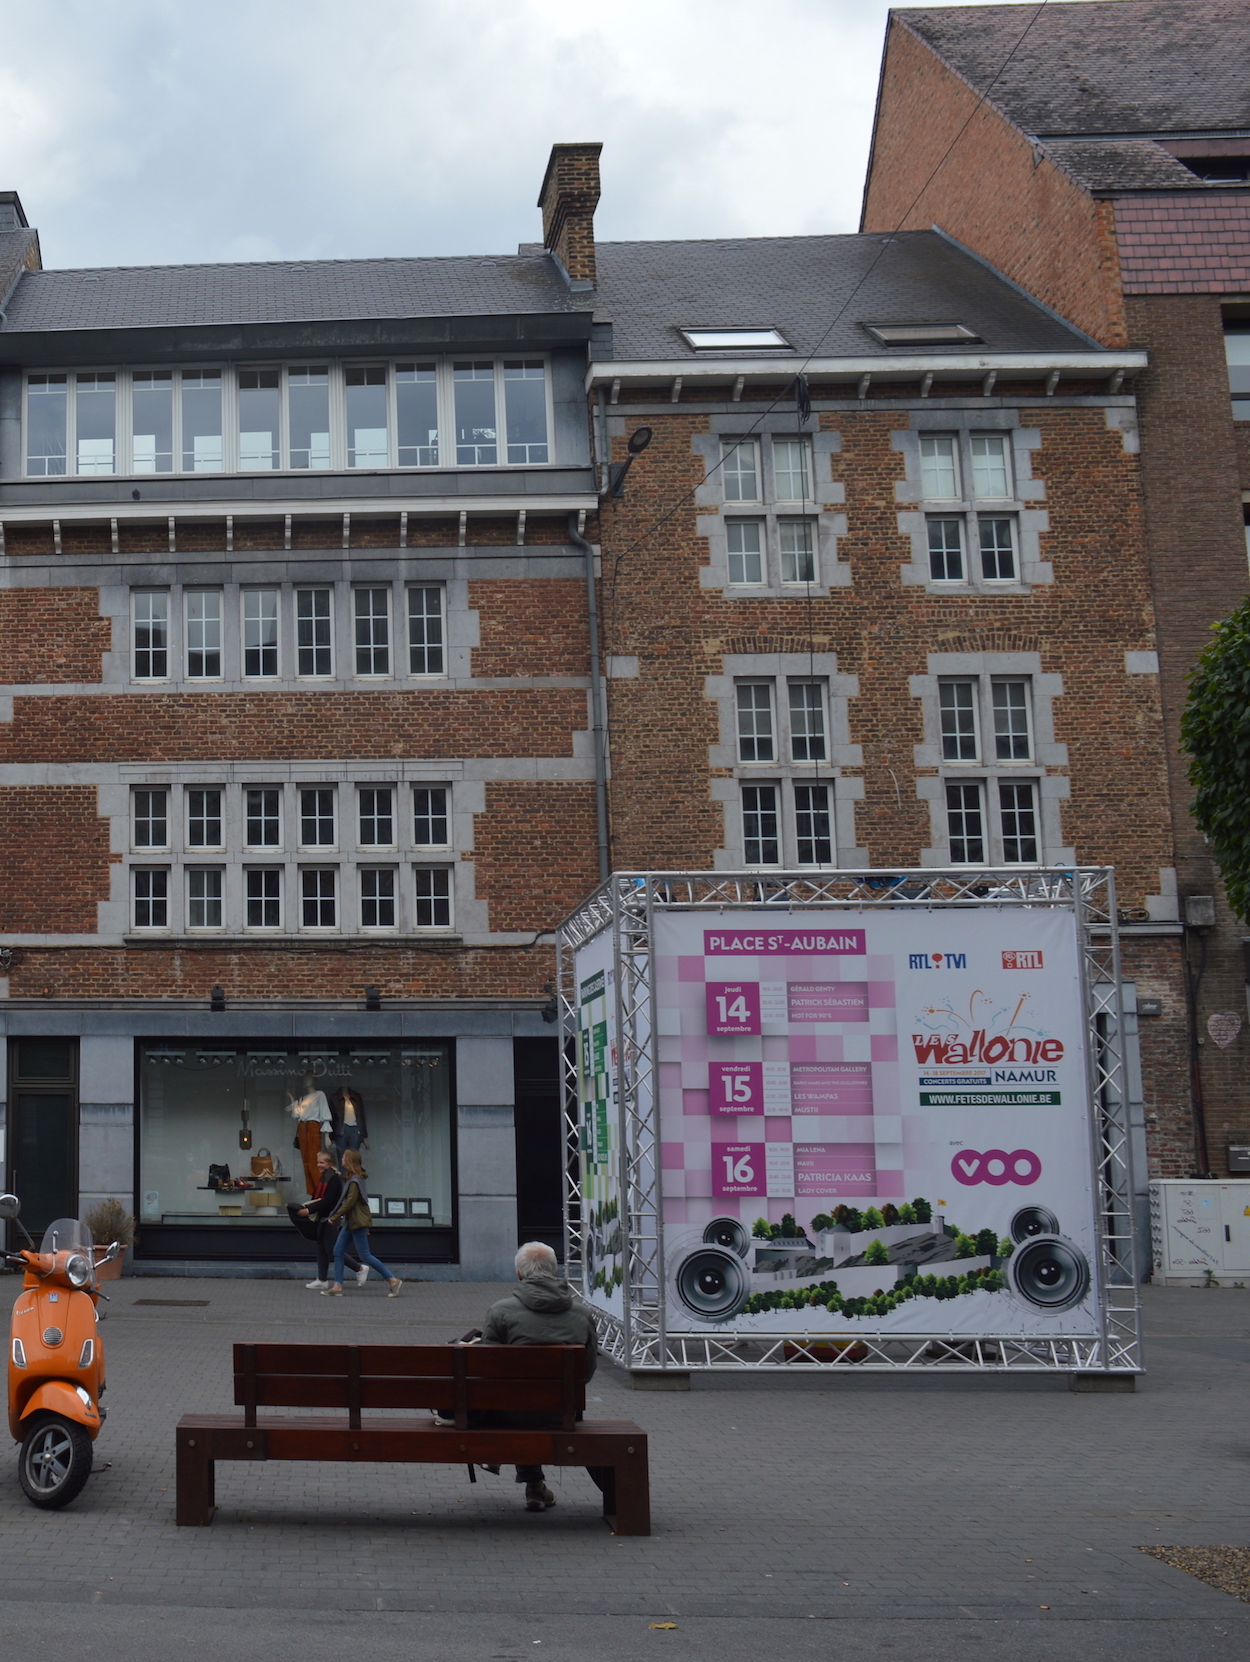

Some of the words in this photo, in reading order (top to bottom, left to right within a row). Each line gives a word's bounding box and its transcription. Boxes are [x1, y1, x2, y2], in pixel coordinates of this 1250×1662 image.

[710, 936, 764, 950] PLACE
[909, 953, 932, 969] RTL
[944, 953, 967, 969] TVI
[1016, 952, 1042, 968] RTL
[724, 986, 741, 994] jeudi
[824, 997, 864, 1005] SÉBASTIEN
[716, 996, 751, 1022] 14
[912, 1029, 1064, 1064] Wallonie
[913, 1034, 957, 1047] LES
[237, 1060, 307, 1077] Massimo
[311, 1060, 353, 1077] Dutti
[995, 1070, 1057, 1082] NAMUR
[721, 1075, 752, 1102] 15
[929, 1094, 1052, 1104] WWW.FETESDEWALLONIE.BE
[722, 1154, 754, 1183] 16
[798, 1172, 842, 1181] PATRICIA
[843, 1172, 871, 1181] KAAS
[722, 1185, 758, 1193] septembre
